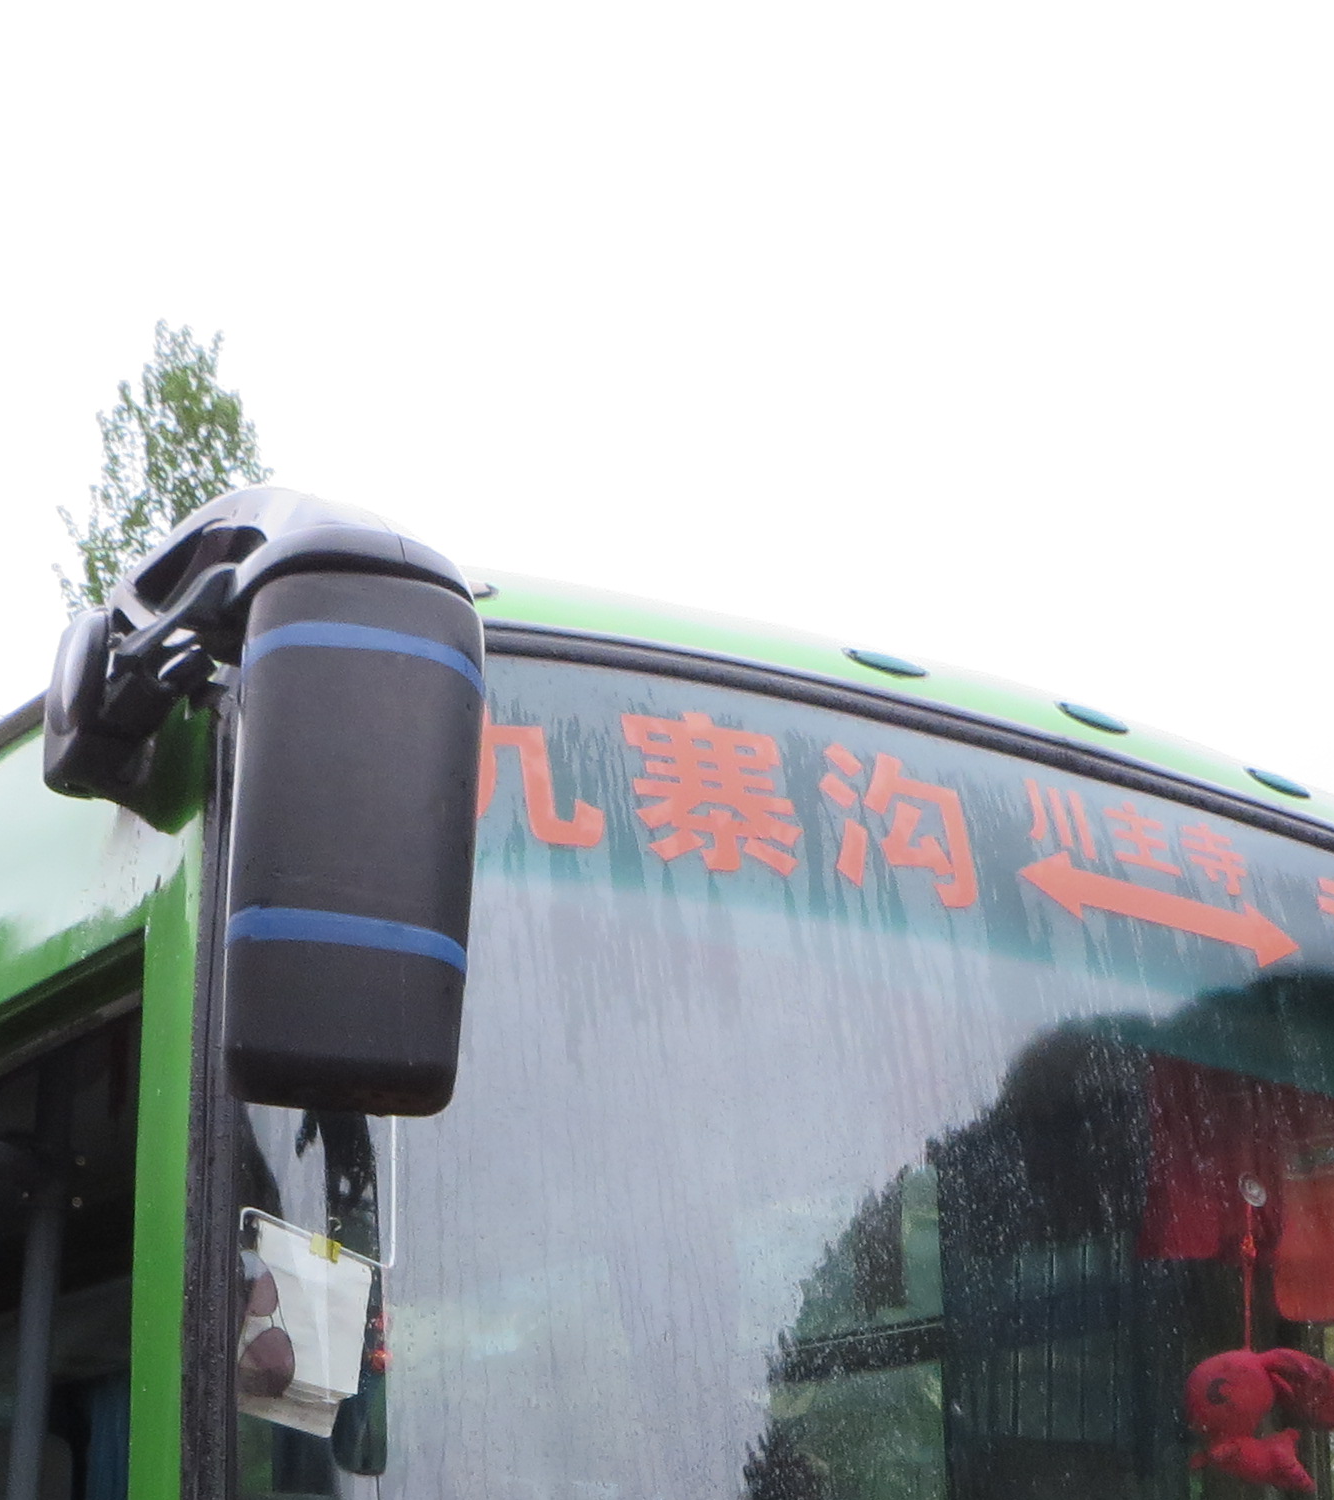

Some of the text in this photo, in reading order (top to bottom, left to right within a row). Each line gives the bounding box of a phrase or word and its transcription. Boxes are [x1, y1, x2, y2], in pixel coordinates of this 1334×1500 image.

[476, 701, 978, 909] 九寨沟
[1026, 777, 1248, 897] 川主寺
